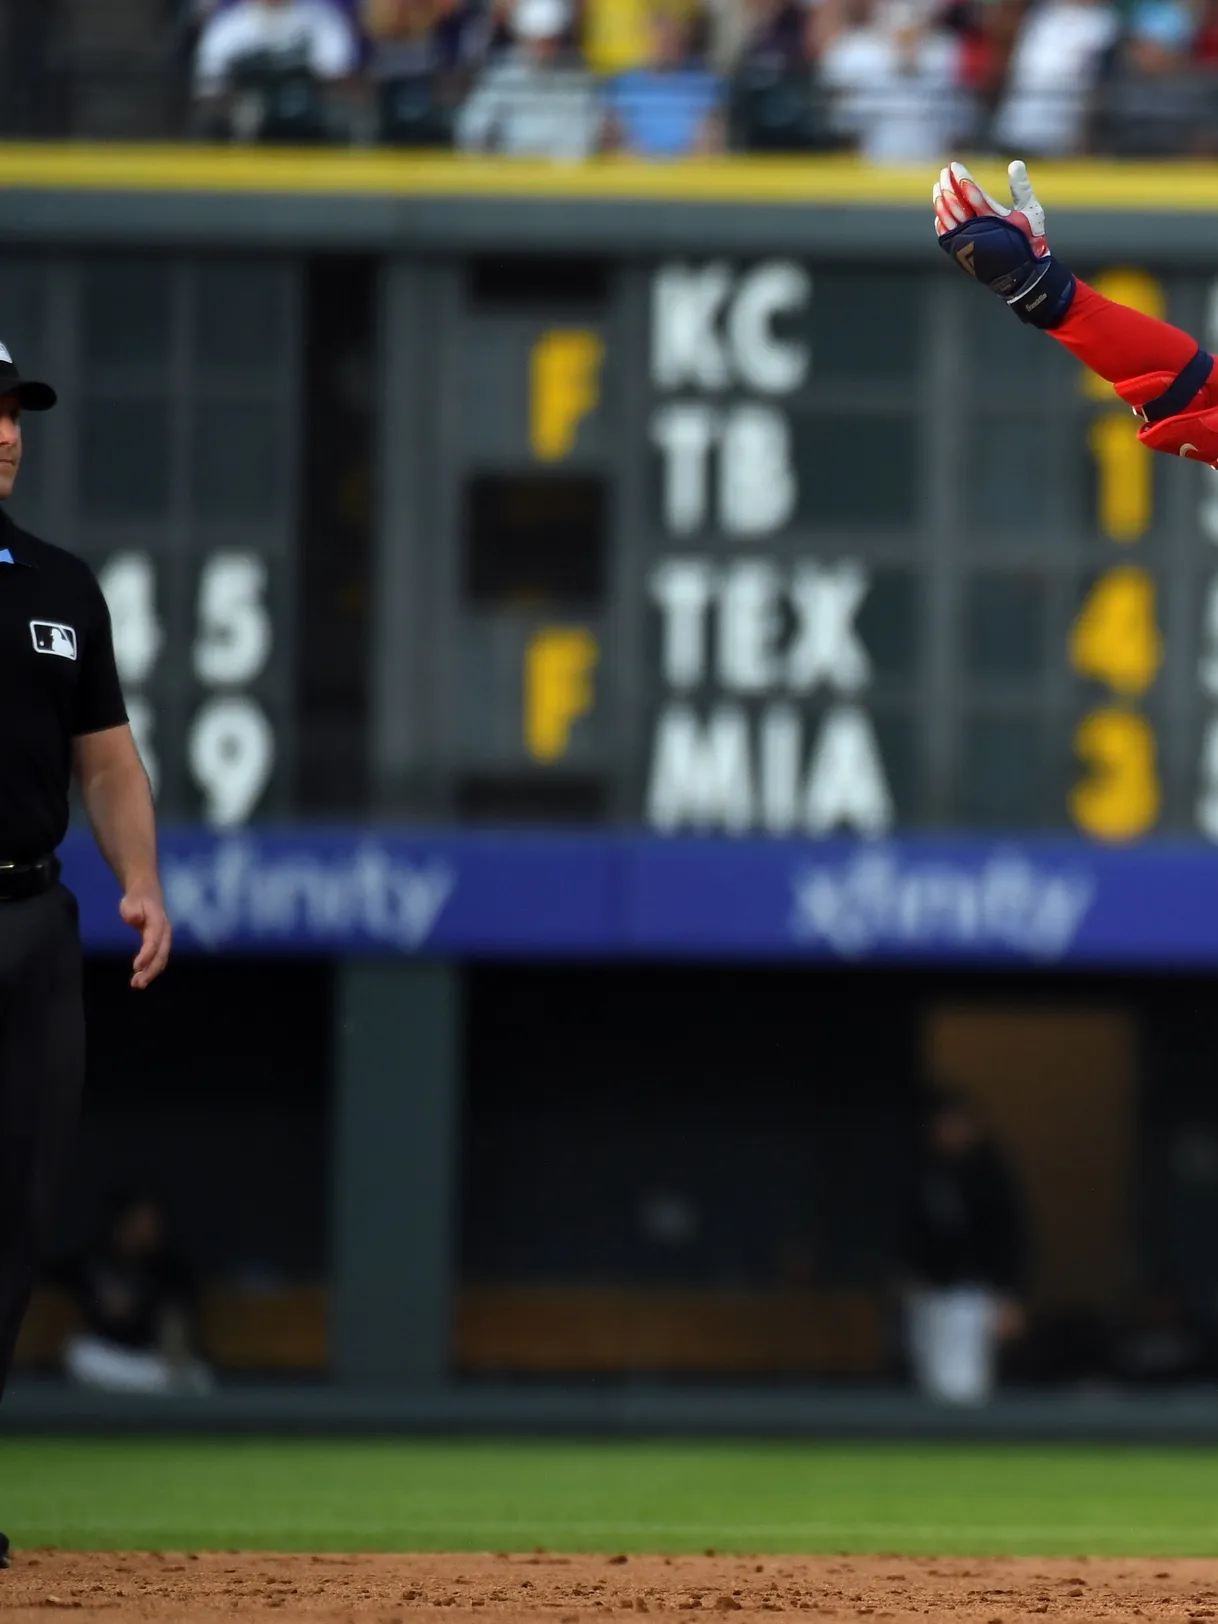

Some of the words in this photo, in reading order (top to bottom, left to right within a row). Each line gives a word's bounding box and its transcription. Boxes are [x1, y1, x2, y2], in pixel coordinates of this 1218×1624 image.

[650, 261, 810, 393] KC
[651, 404, 798, 537] TB
[1086, 413, 1152, 541] 1
[192, 550, 272, 685] 5
[650, 558, 872, 693] TEX
[1070, 566, 1160, 694] 4
[189, 695, 274, 831] 9
[648, 705, 893, 840] MIA
[1070, 708, 1160, 843] 3
[163, 838, 456, 950] xfinity
[790, 848, 1098, 960] xfinity
